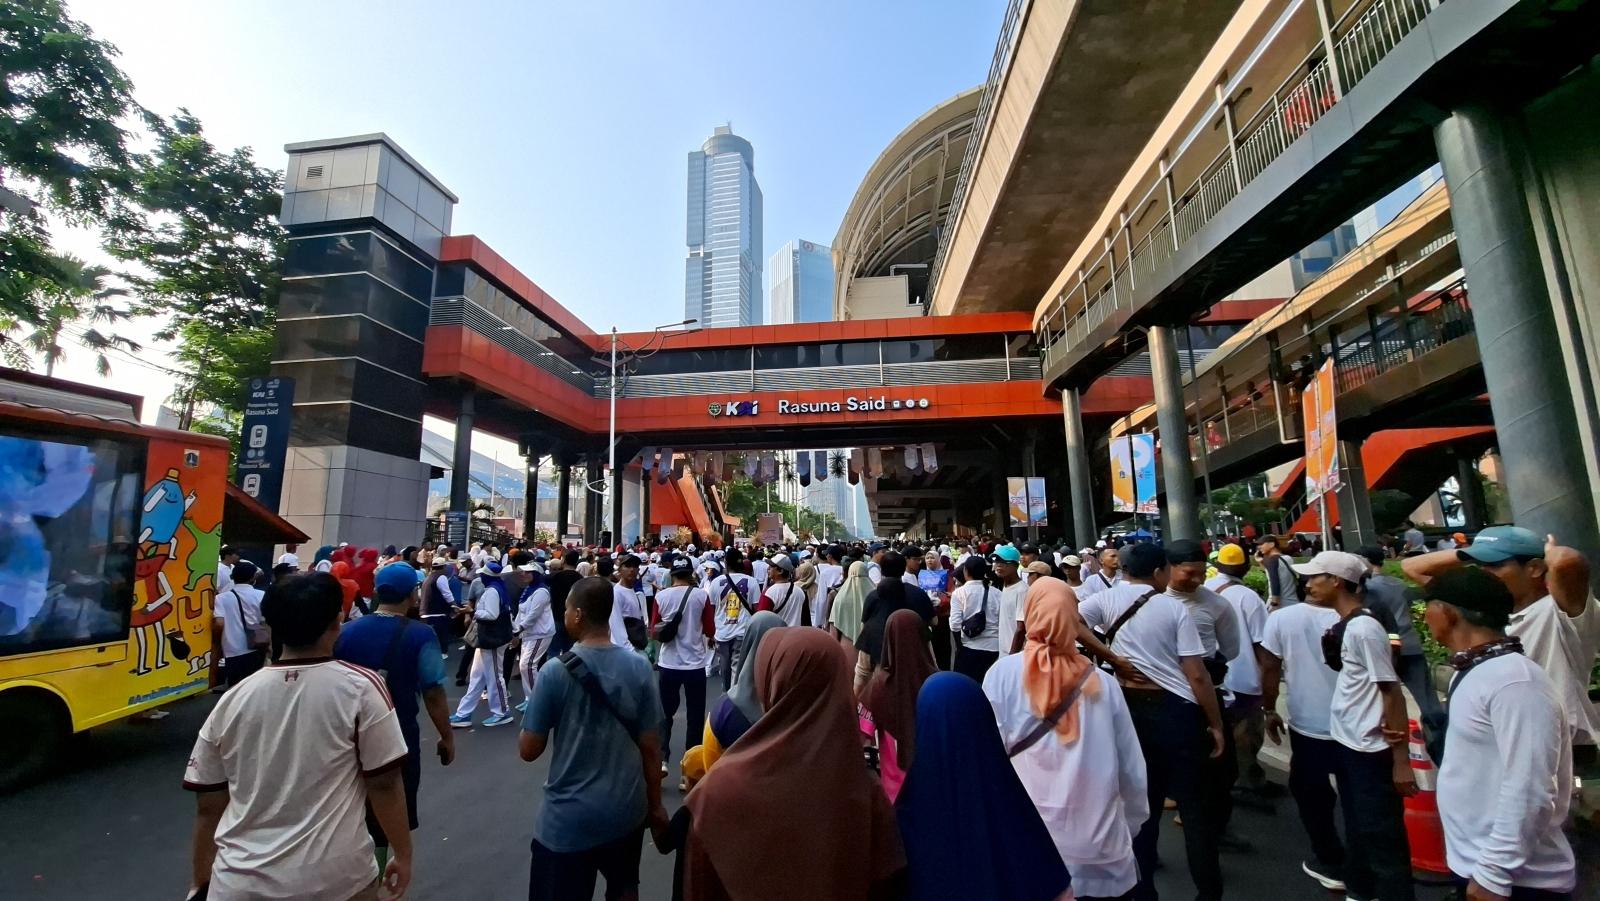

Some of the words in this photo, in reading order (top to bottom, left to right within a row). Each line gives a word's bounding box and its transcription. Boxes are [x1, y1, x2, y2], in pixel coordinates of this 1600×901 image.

[778, 399, 841, 414] Rasuna
[846, 395, 886, 411] Said
[245, 408, 265, 416] Rasuna
[266, 408, 279, 416] Said
